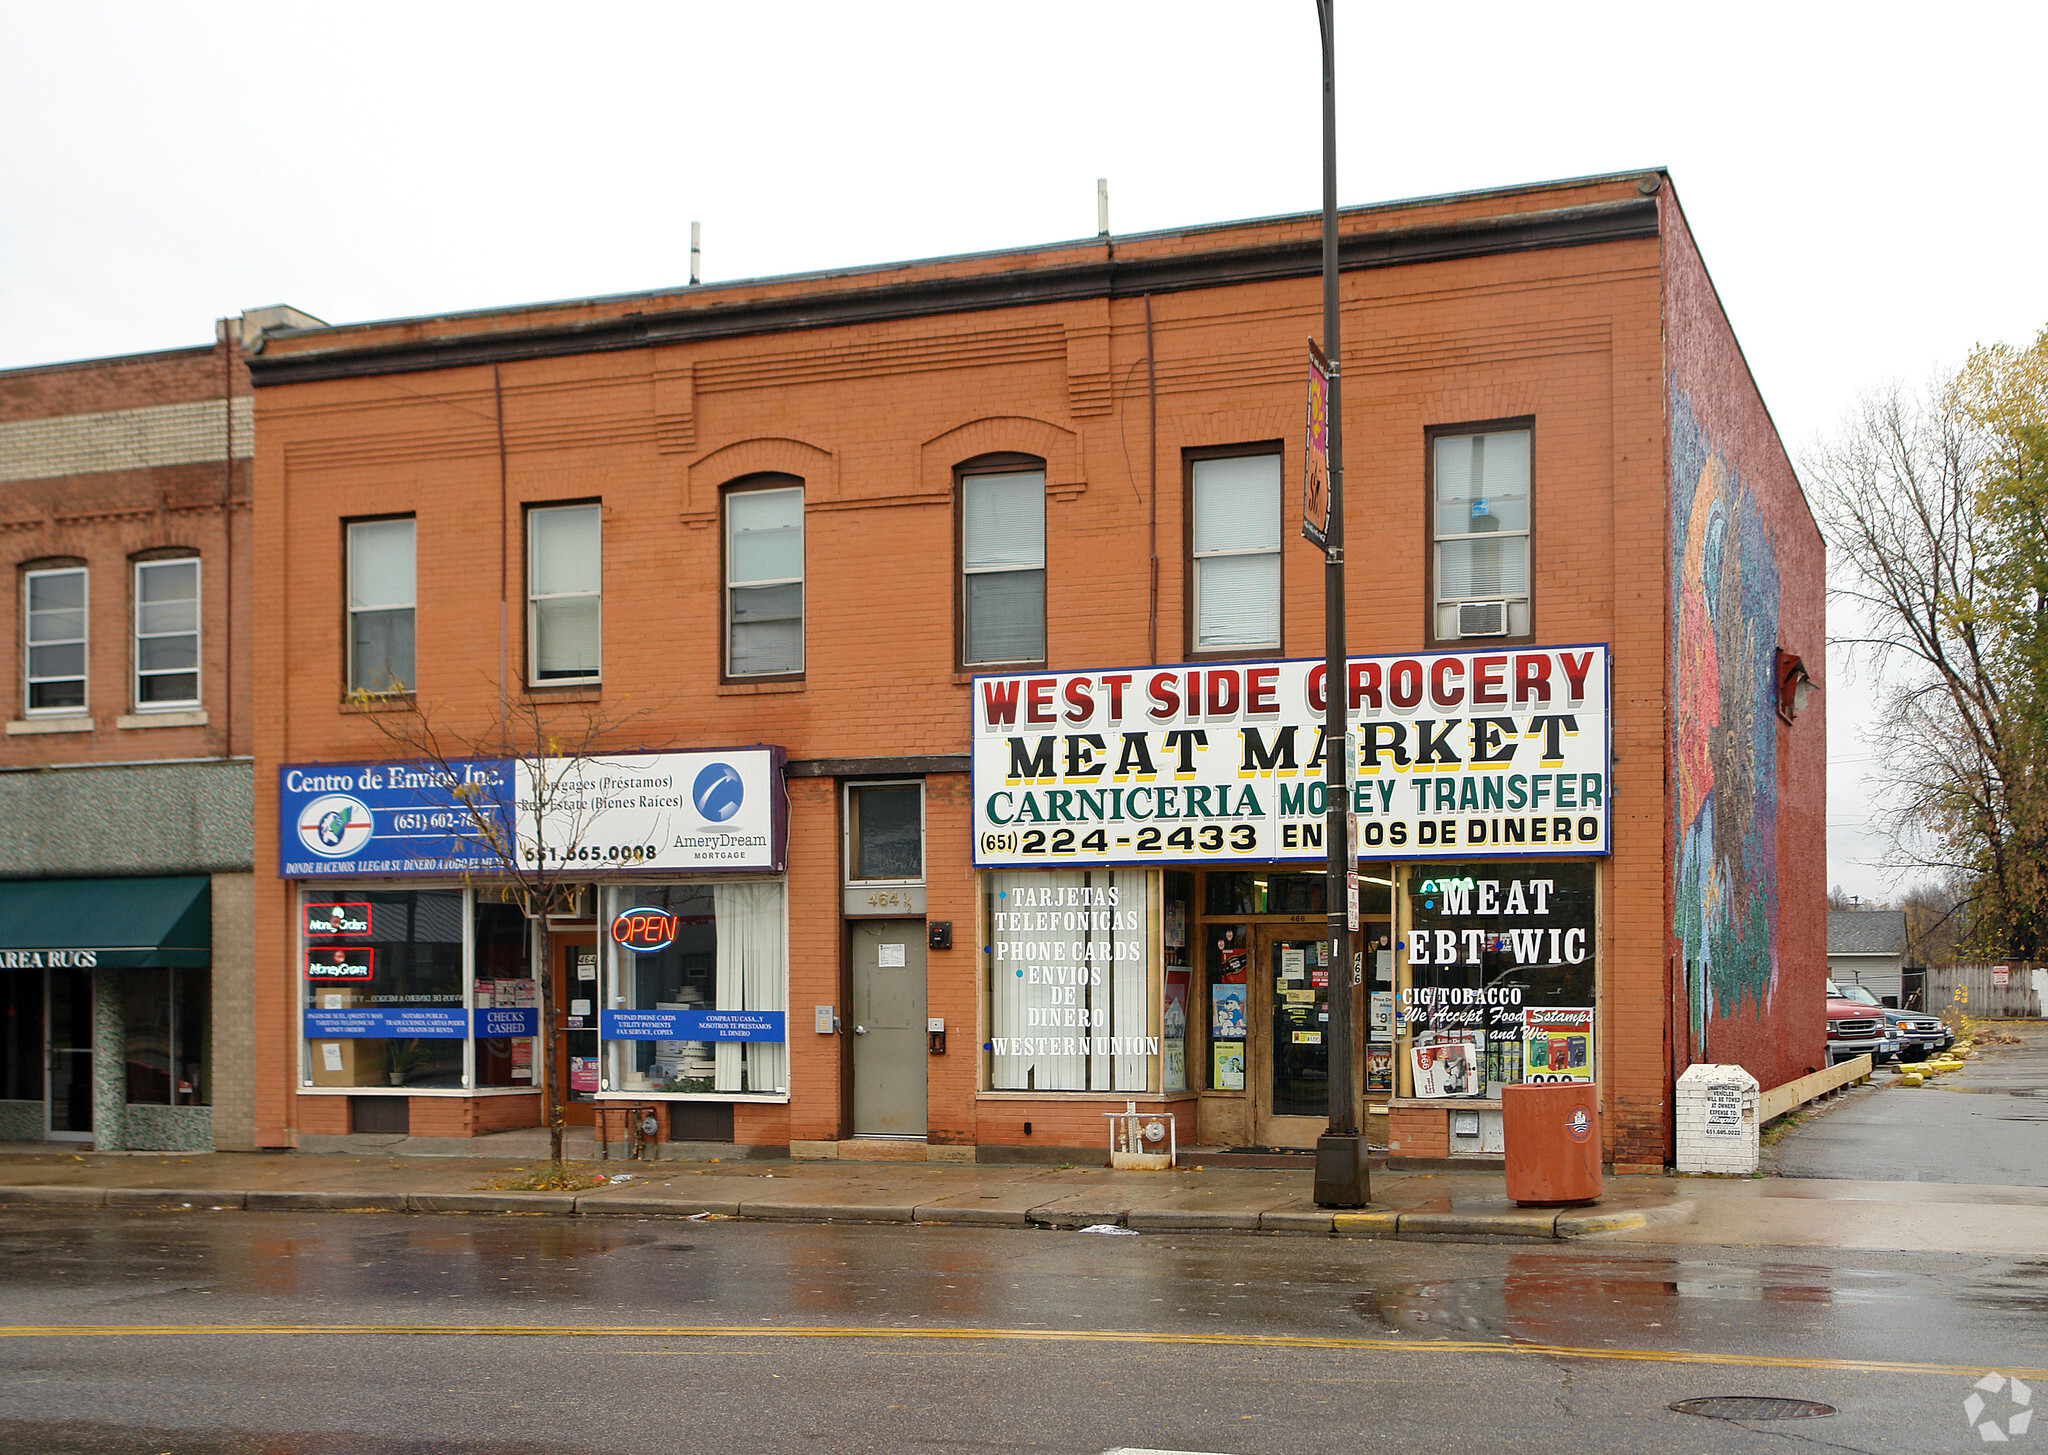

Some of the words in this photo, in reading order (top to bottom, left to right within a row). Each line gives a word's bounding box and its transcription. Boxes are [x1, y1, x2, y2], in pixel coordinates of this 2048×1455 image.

[983, 674, 1133, 727] WEST
[1149, 667, 1280, 719] SIDE
[1308, 651, 1594, 712] GROCERY
[1007, 730, 1209, 779] MEAT
[286, 770, 353, 793] Centro
[358, 768, 383, 790] de
[387, 766, 458, 789] Envios
[463, 764, 505, 786] Inc.
[532, 777, 596, 793] ortgages
[599, 774, 673, 791] (Préstamos)
[521, 799, 547, 811] Rel
[550, 798, 588, 811] Estate
[591, 796, 636, 812] (Bienes
[639, 794, 683, 811] Raíces)
[986, 784, 1266, 825] CARNICERIA
[1280, 779, 1396, 815] MOEY
[1411, 773, 1602, 813] TRANSFER
[394, 813, 428, 832] (651)
[673, 833, 767, 849] AmeryDream
[980, 831, 1018, 854] (651)
[1021, 824, 1258, 854] 224-2433
[1283, 820, 1407, 847] ENOS
[1418, 819, 1457, 845] DE
[1467, 816, 1599, 845] DINERO
[694, 851, 746, 860] MORTGAGE
[285, 861, 314, 874] DONDE
[316, 860, 355, 873] HACEMOS
[358, 860, 391, 871] LLEGAR
[391, 859, 403, 871] SU
[404, 859, 437, 871] DINERO
[436, 859, 443, 870] A
[1420, 877, 1475, 893] ATM
[867, 891, 900, 907] 464
[1012, 887, 1120, 907] TARJETAS
[1440, 879, 1554, 916] MEAT
[339, 918, 368, 931] Orders
[612, 915, 678, 942] OPEN
[994, 910, 1138, 932] TELEFONICAS
[1290, 915, 1306, 923] 466
[996, 941, 1066, 961] PHONE
[1071, 941, 1141, 961] CARDS
[1407, 929, 1485, 965] EBT
[1508, 928, 1586, 965] WIC
[48, 950, 98, 969] RUGS
[579, 954, 597, 965] 464
[308, 962, 368, 977] MoneyGram
[1028, 966, 1102, 986] ENVIOS
[1050, 986, 1076, 1005] DE
[1402, 988, 1522, 1006] CIG/TOBACCO
[487, 1012, 525, 1021] CHECKS
[1027, 1007, 1104, 1027] DINERO
[1403, 1006, 1427, 1022] We
[1430, 1005, 1484, 1026] Accept
[1489, 1006, 1525, 1025] Food
[487, 1023, 525, 1033] CASHED
[1489, 1026, 1516, 1040] and
[1519, 1025, 1549, 1041] Wic
[991, 1036, 1091, 1056] WESTERN
[1095, 1036, 1159, 1056] UNION
[1711, 1116, 1737, 1124] Rapid
